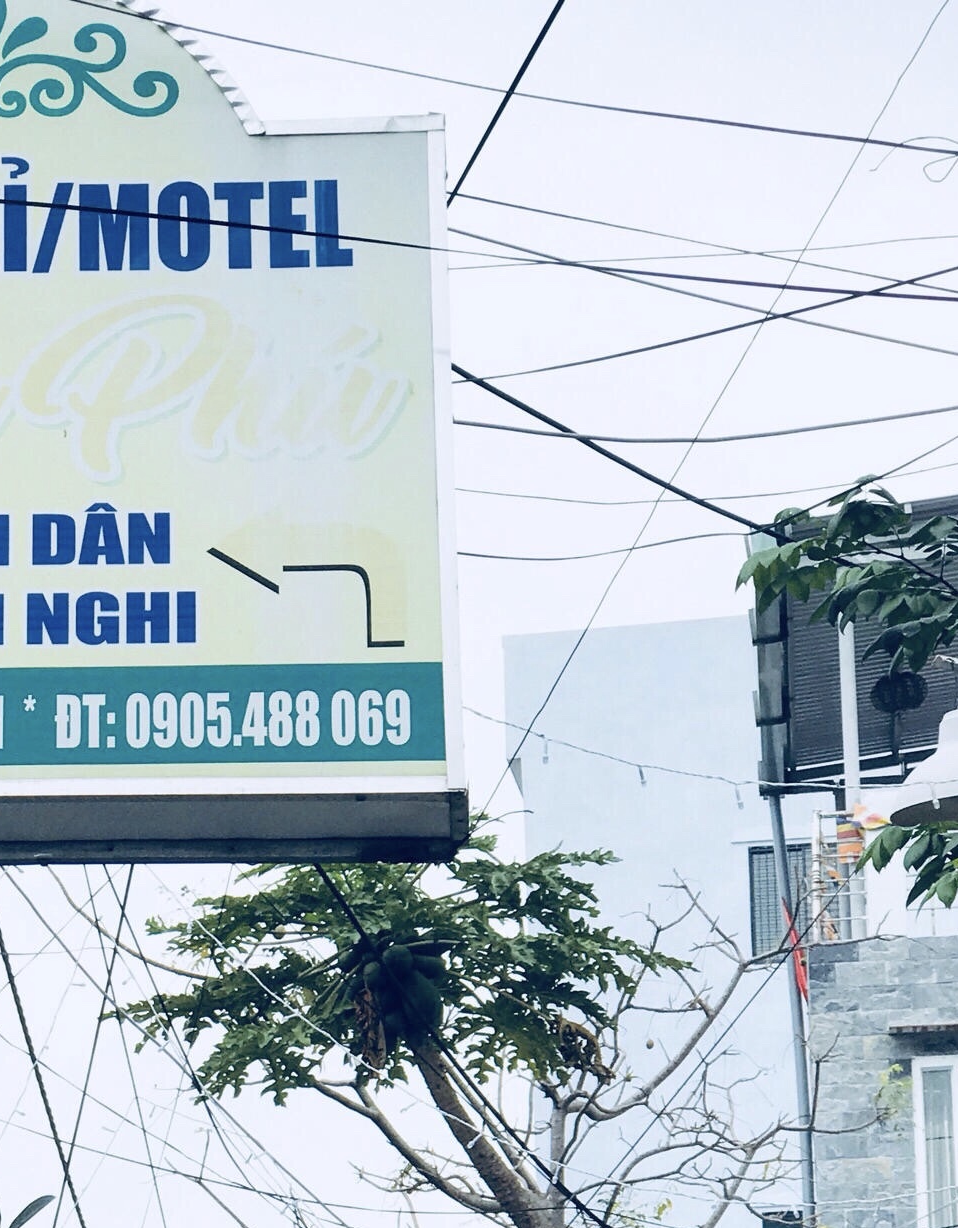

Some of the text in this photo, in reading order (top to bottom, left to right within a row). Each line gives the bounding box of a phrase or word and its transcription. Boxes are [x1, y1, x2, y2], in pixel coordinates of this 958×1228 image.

[32, 502, 171, 566] DÂN
[26, 590, 196, 646] NGHI
[54, 693, 116, 749] ĐT:
[125, 690, 320, 749] 0905.488
[330, 689, 411, 746] 069
